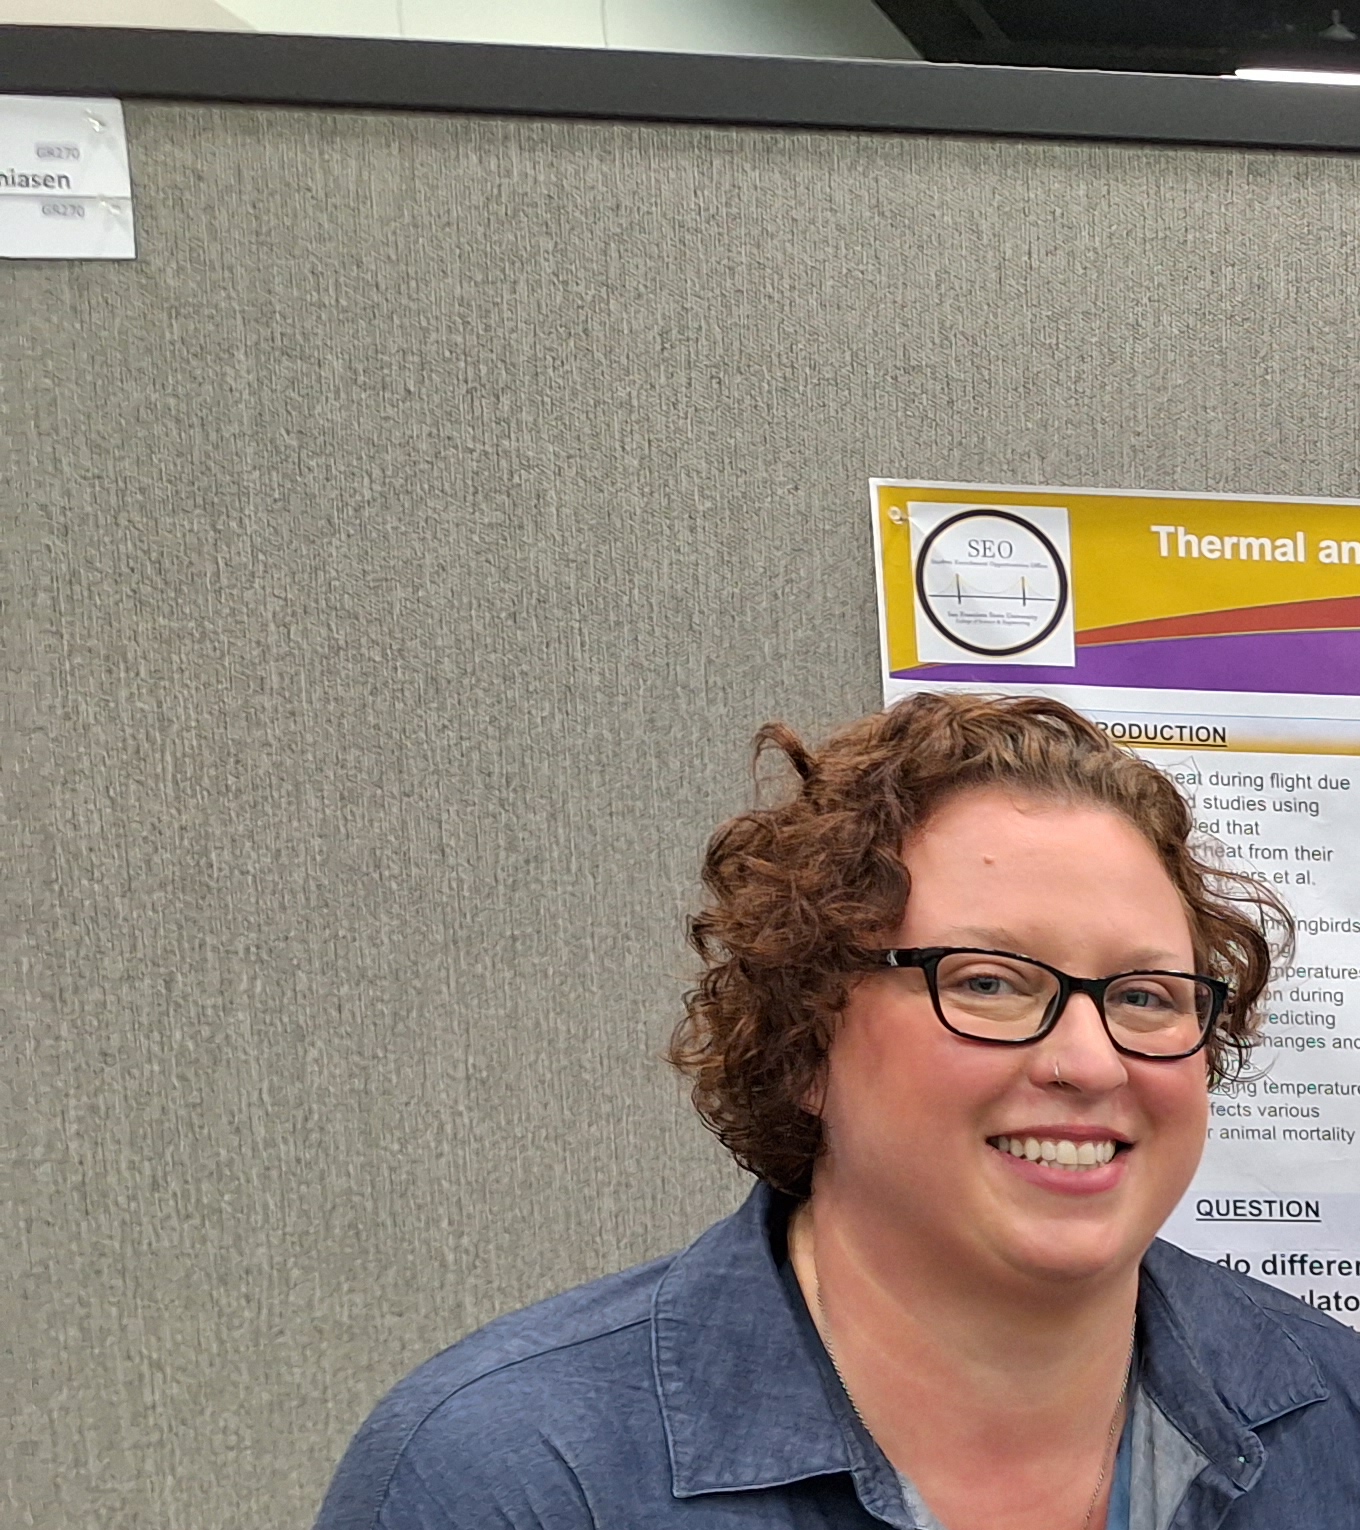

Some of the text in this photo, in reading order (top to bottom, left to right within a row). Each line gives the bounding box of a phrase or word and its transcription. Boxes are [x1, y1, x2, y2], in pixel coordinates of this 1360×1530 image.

[968, 539, 1013, 559] SEO
[1150, 525, 1306, 563] Thermal
[1209, 772, 1351, 793] during flight due
[1203, 796, 1320, 817] studies using
[1226, 820, 1260, 836] that
[1248, 844, 1334, 862] from their
[1257, 1103, 1320, 1118] various
[1219, 1125, 1356, 1145] animal mortality
[1196, 1199, 1320, 1218] QUESTION
